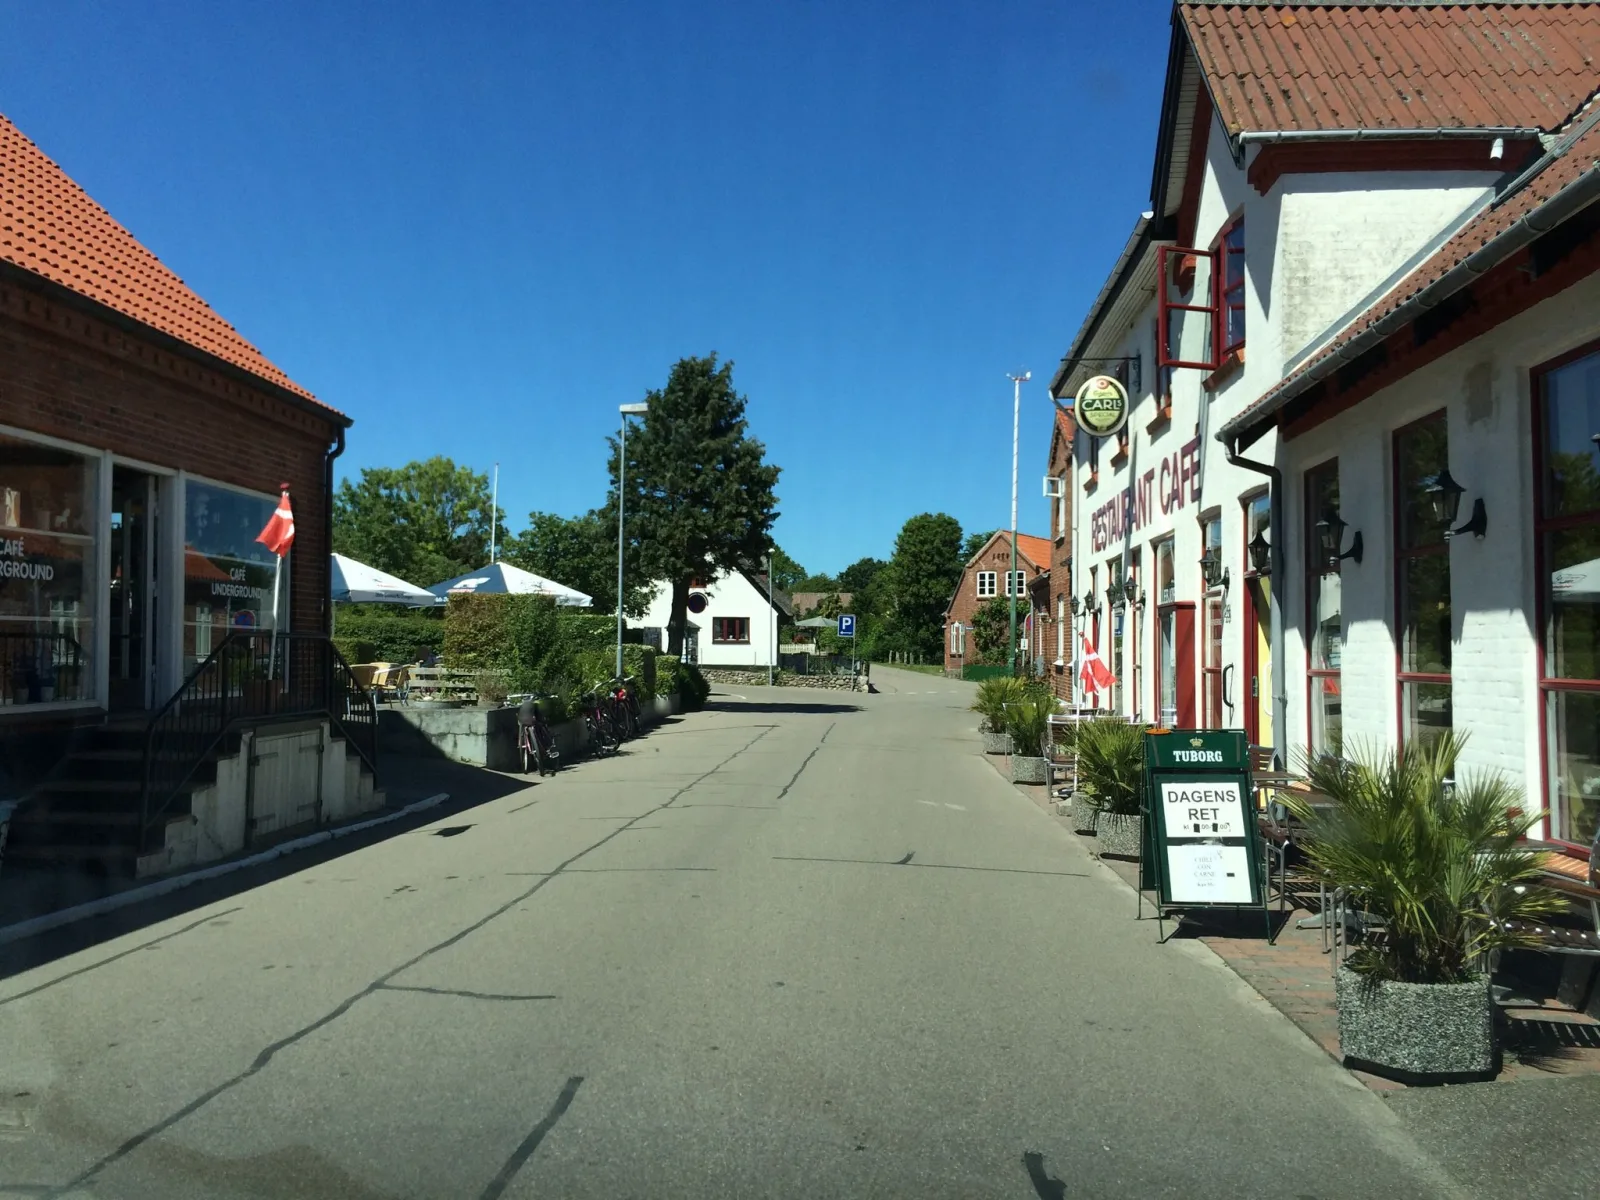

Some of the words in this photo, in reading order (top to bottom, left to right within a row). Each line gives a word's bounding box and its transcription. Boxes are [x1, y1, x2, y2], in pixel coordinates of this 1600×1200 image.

[1091, 467, 1155, 555] RESTAURANT
[211, 582, 262, 599] UNDERGROUND
[842, 617, 852, 630] P
[1173, 750, 1223, 763] TUBORG
[1168, 790, 1236, 803] DAGENS
[1187, 808, 1220, 821] RET
